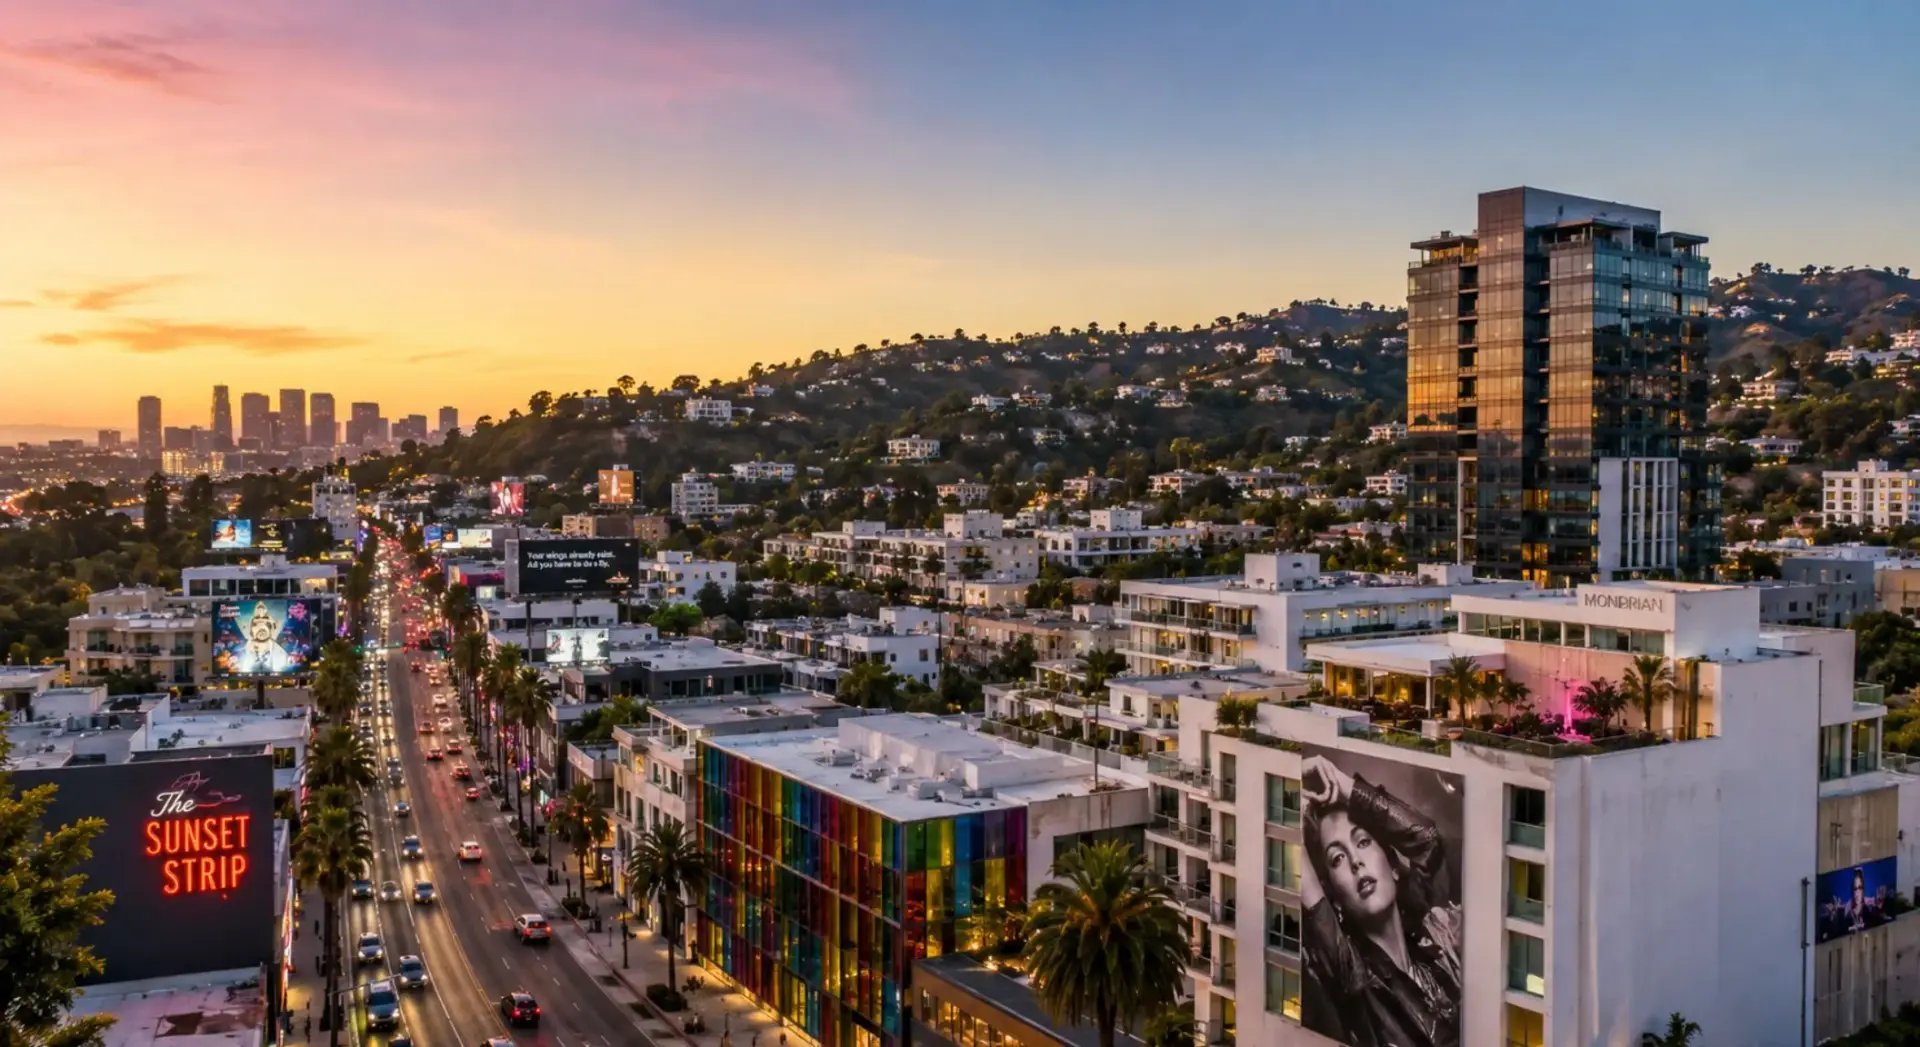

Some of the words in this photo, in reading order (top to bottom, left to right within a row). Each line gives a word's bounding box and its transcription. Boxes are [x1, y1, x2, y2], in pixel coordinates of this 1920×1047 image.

[540, 562, 553, 570] you
[150, 789, 196, 817] The
[146, 816, 250, 854] SUNSET
[163, 855, 247, 894] STRIP
